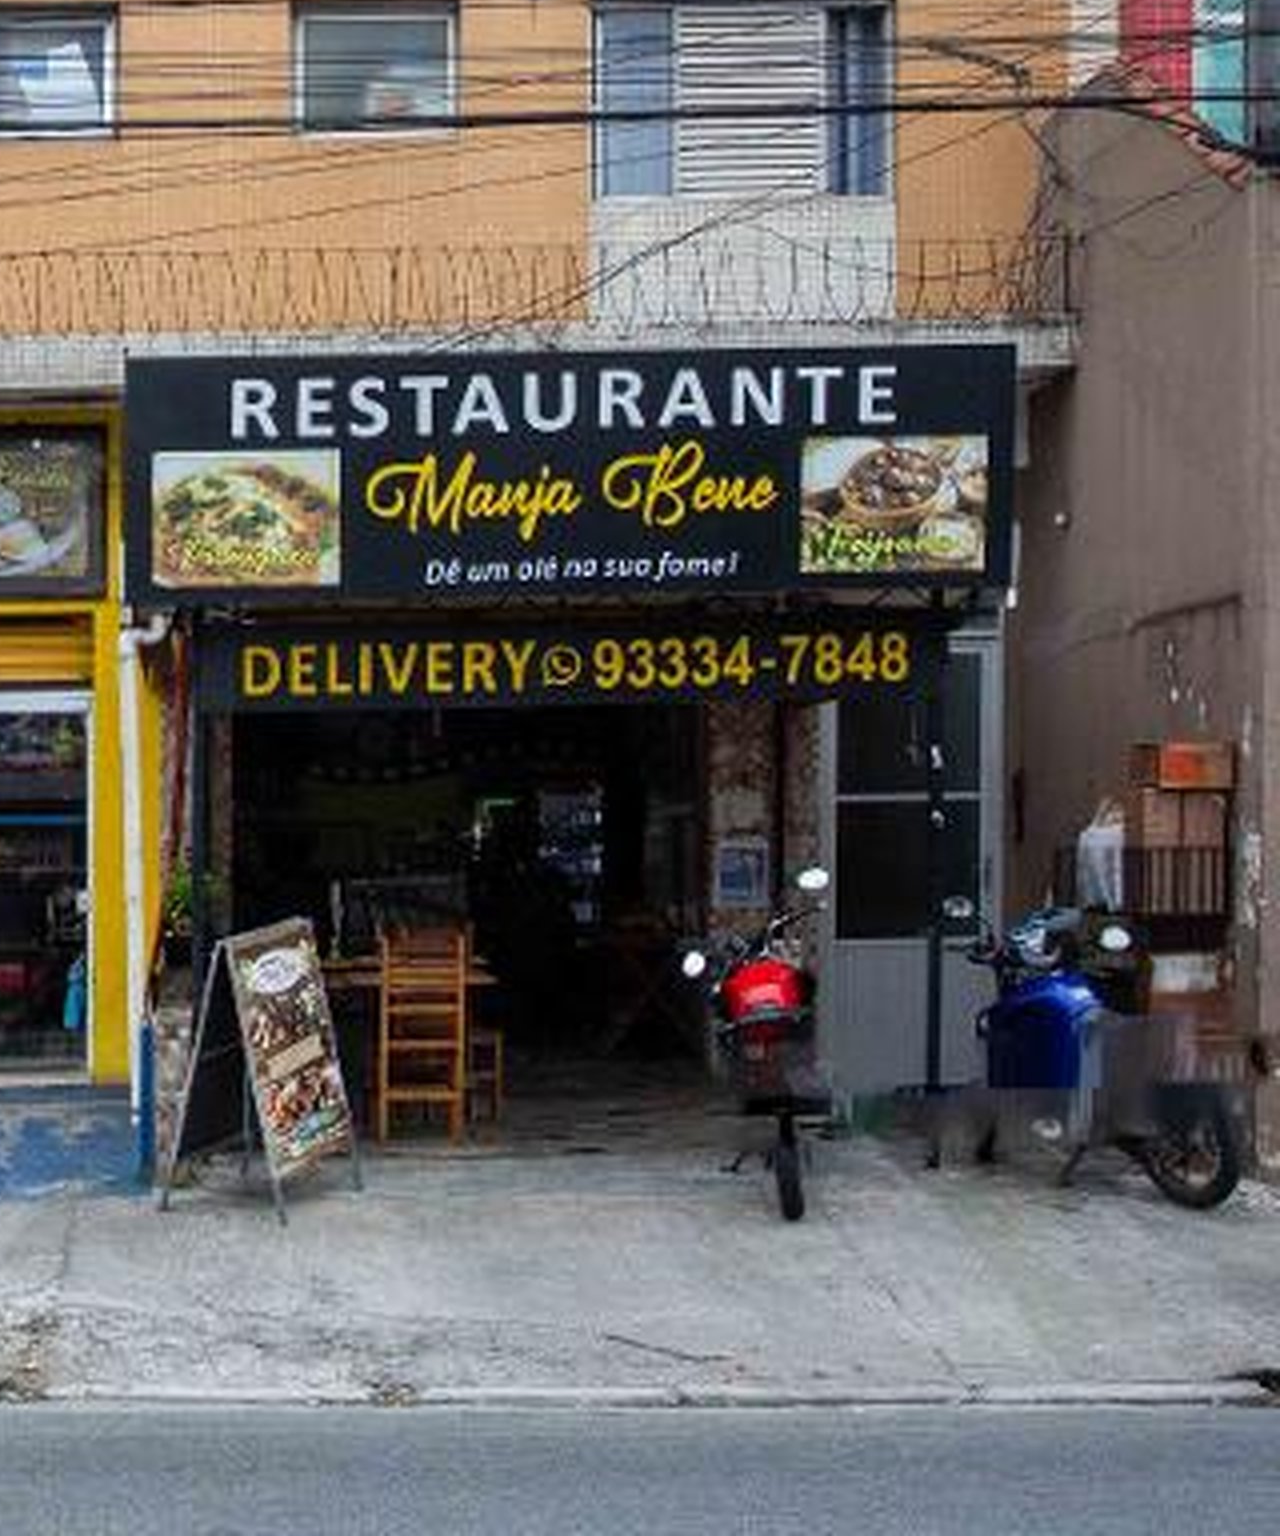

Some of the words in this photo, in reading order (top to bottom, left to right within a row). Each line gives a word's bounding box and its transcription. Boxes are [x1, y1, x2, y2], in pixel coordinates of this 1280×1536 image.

[230, 366, 897, 438] RESTAURANTE
[366, 451, 582, 540] Manja
[602, 441, 780, 527] Bene
[467, 565, 509, 583] um
[603, 559, 651, 578] sua
[655, 551, 739, 582] fome!
[242, 640, 537, 696] DELIVERY
[594, 633, 910, 688] 93334-7848
